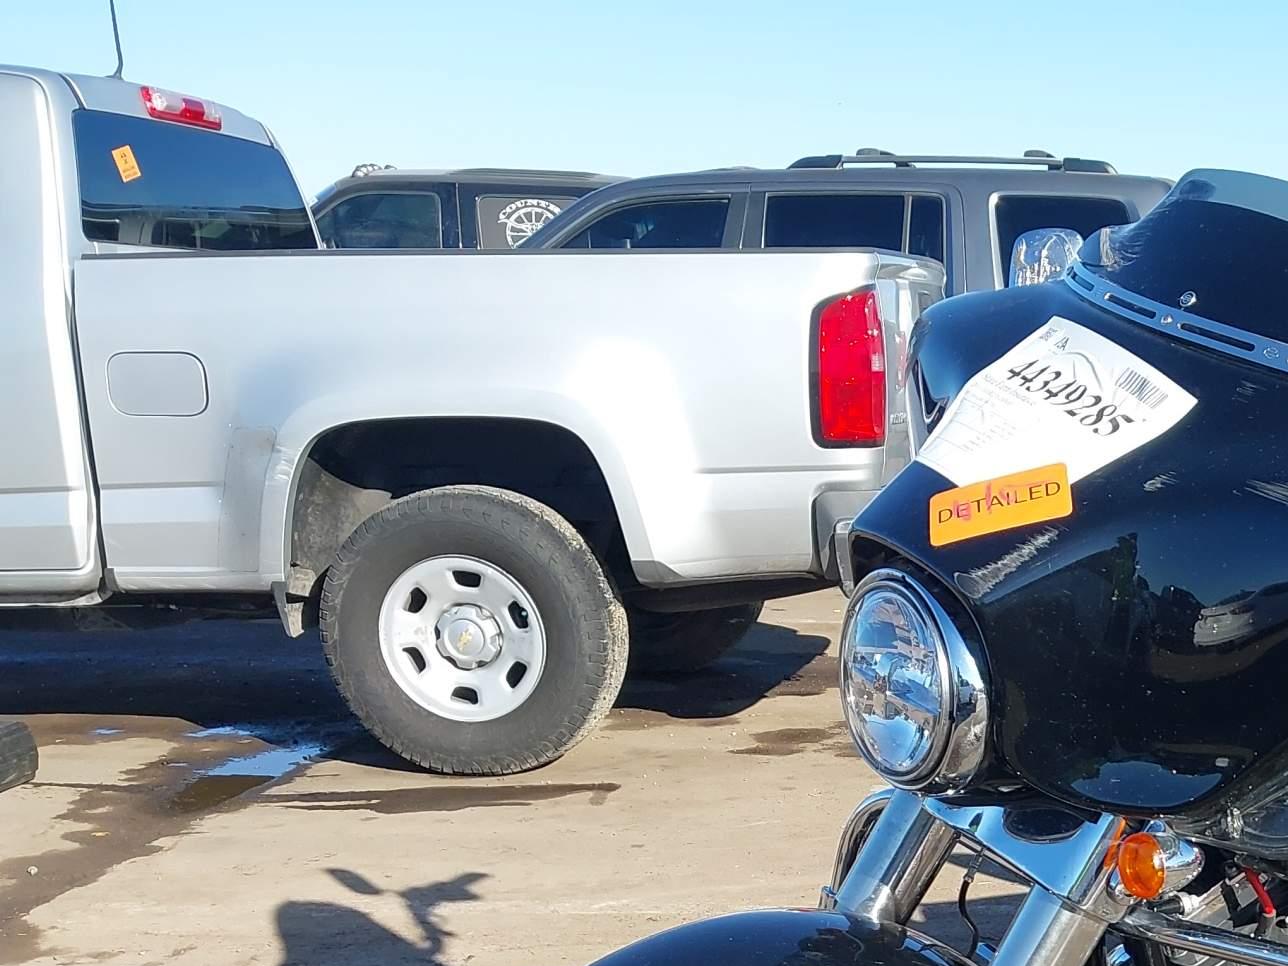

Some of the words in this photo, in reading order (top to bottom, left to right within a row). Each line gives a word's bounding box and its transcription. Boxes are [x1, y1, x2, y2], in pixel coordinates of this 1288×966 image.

[499, 199, 563, 219] COUNTR
[1006, 359, 1136, 437] 44349285
[937, 481, 1061, 524] DETAILED
